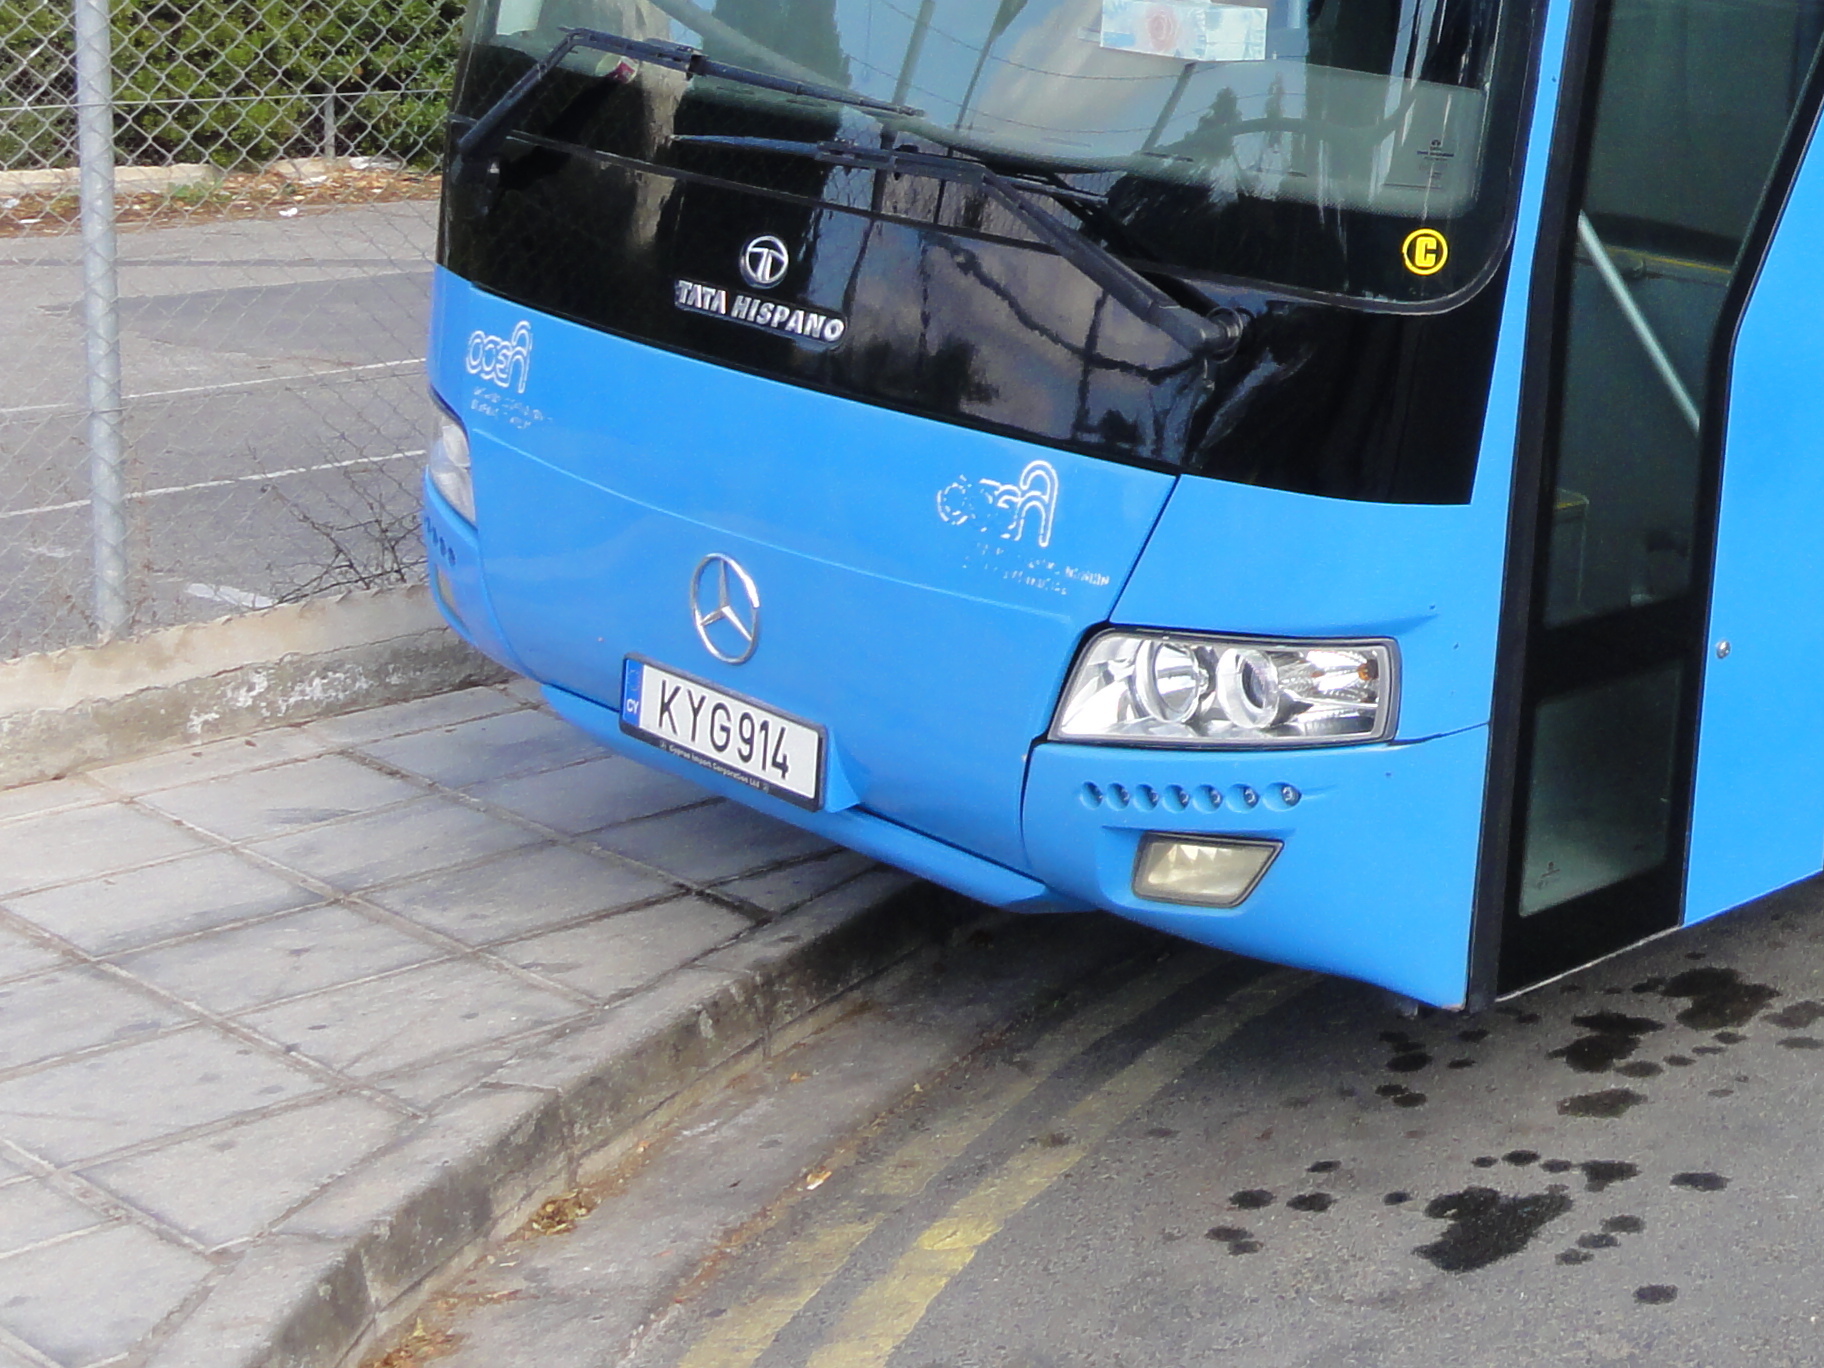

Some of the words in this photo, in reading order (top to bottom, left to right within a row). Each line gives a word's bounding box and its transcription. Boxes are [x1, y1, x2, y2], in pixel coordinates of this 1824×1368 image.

[1415, 236, 1437, 268] C
[676, 280, 727, 315] TATA
[730, 294, 845, 343] HISPANO
[626, 698, 639, 715] CY
[657, 678, 791, 781] KYG914
[668, 744, 692, 761] Cyprus
[712, 762, 750, 785] Corporation
